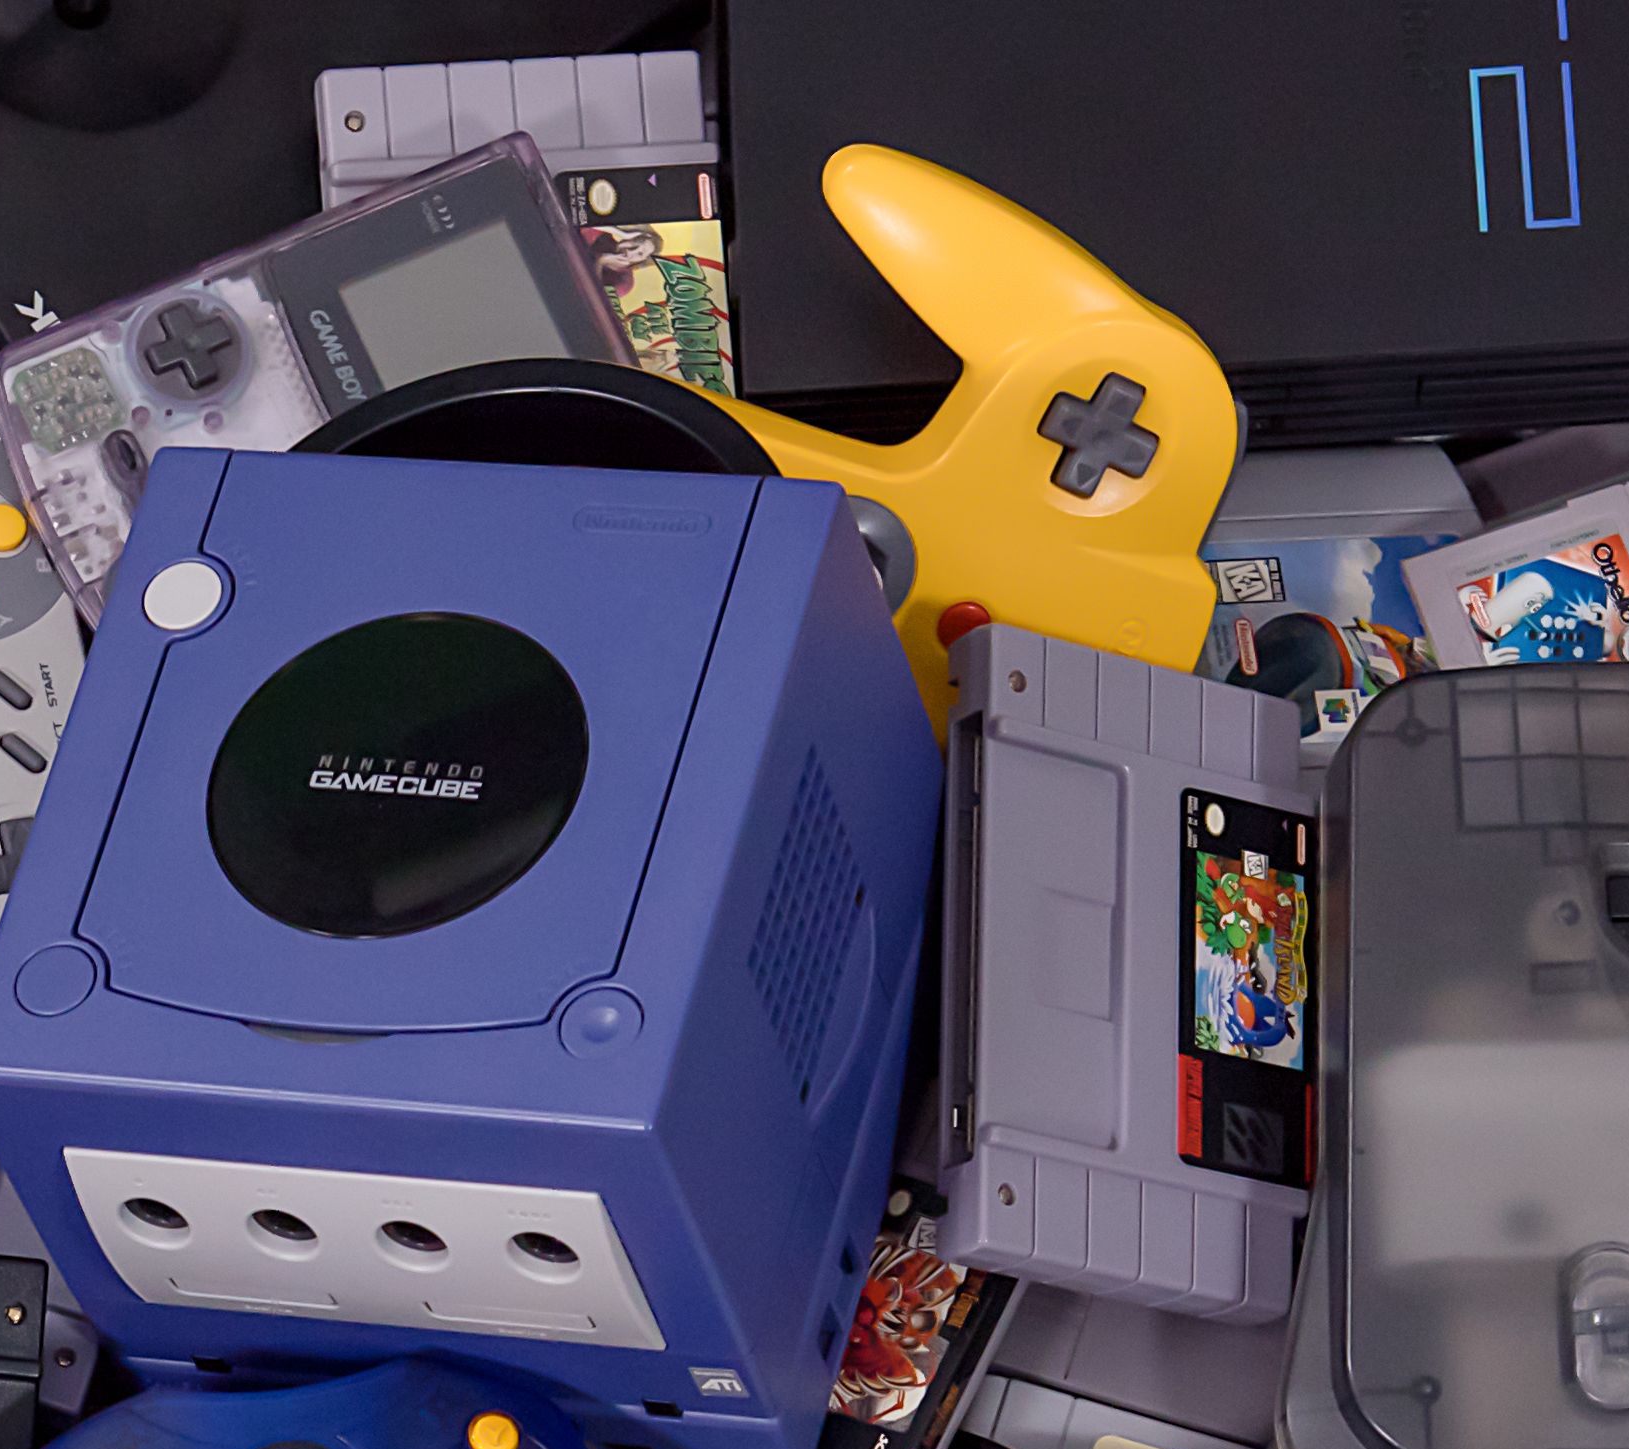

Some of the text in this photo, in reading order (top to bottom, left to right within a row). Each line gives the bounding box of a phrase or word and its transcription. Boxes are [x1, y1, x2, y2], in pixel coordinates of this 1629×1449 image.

[40, 662, 61, 707] START
[319, 755, 485, 780] NINTENDO
[310, 770, 483, 800] GAMECUBE
